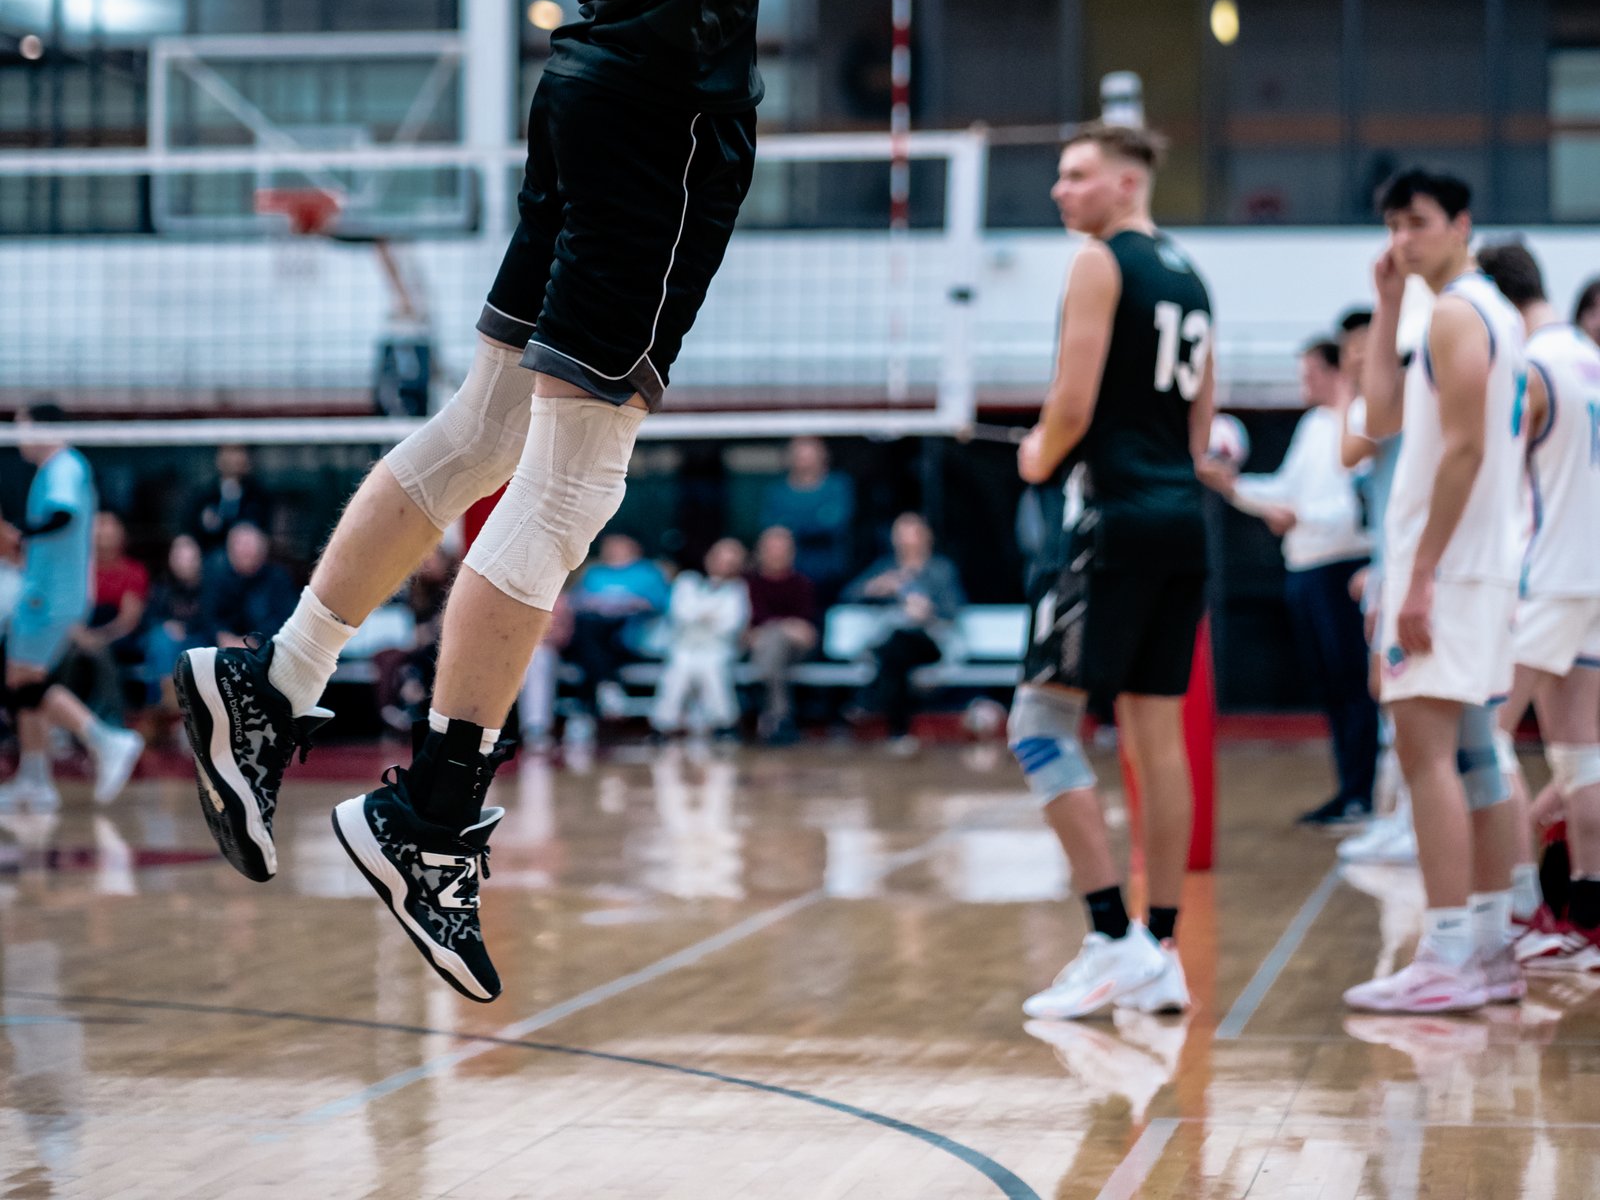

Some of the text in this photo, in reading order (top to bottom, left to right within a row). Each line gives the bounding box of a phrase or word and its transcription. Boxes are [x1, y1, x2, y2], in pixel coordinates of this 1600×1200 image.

[1153, 300, 1212, 401] 13
[220, 676, 243, 743] new balance
